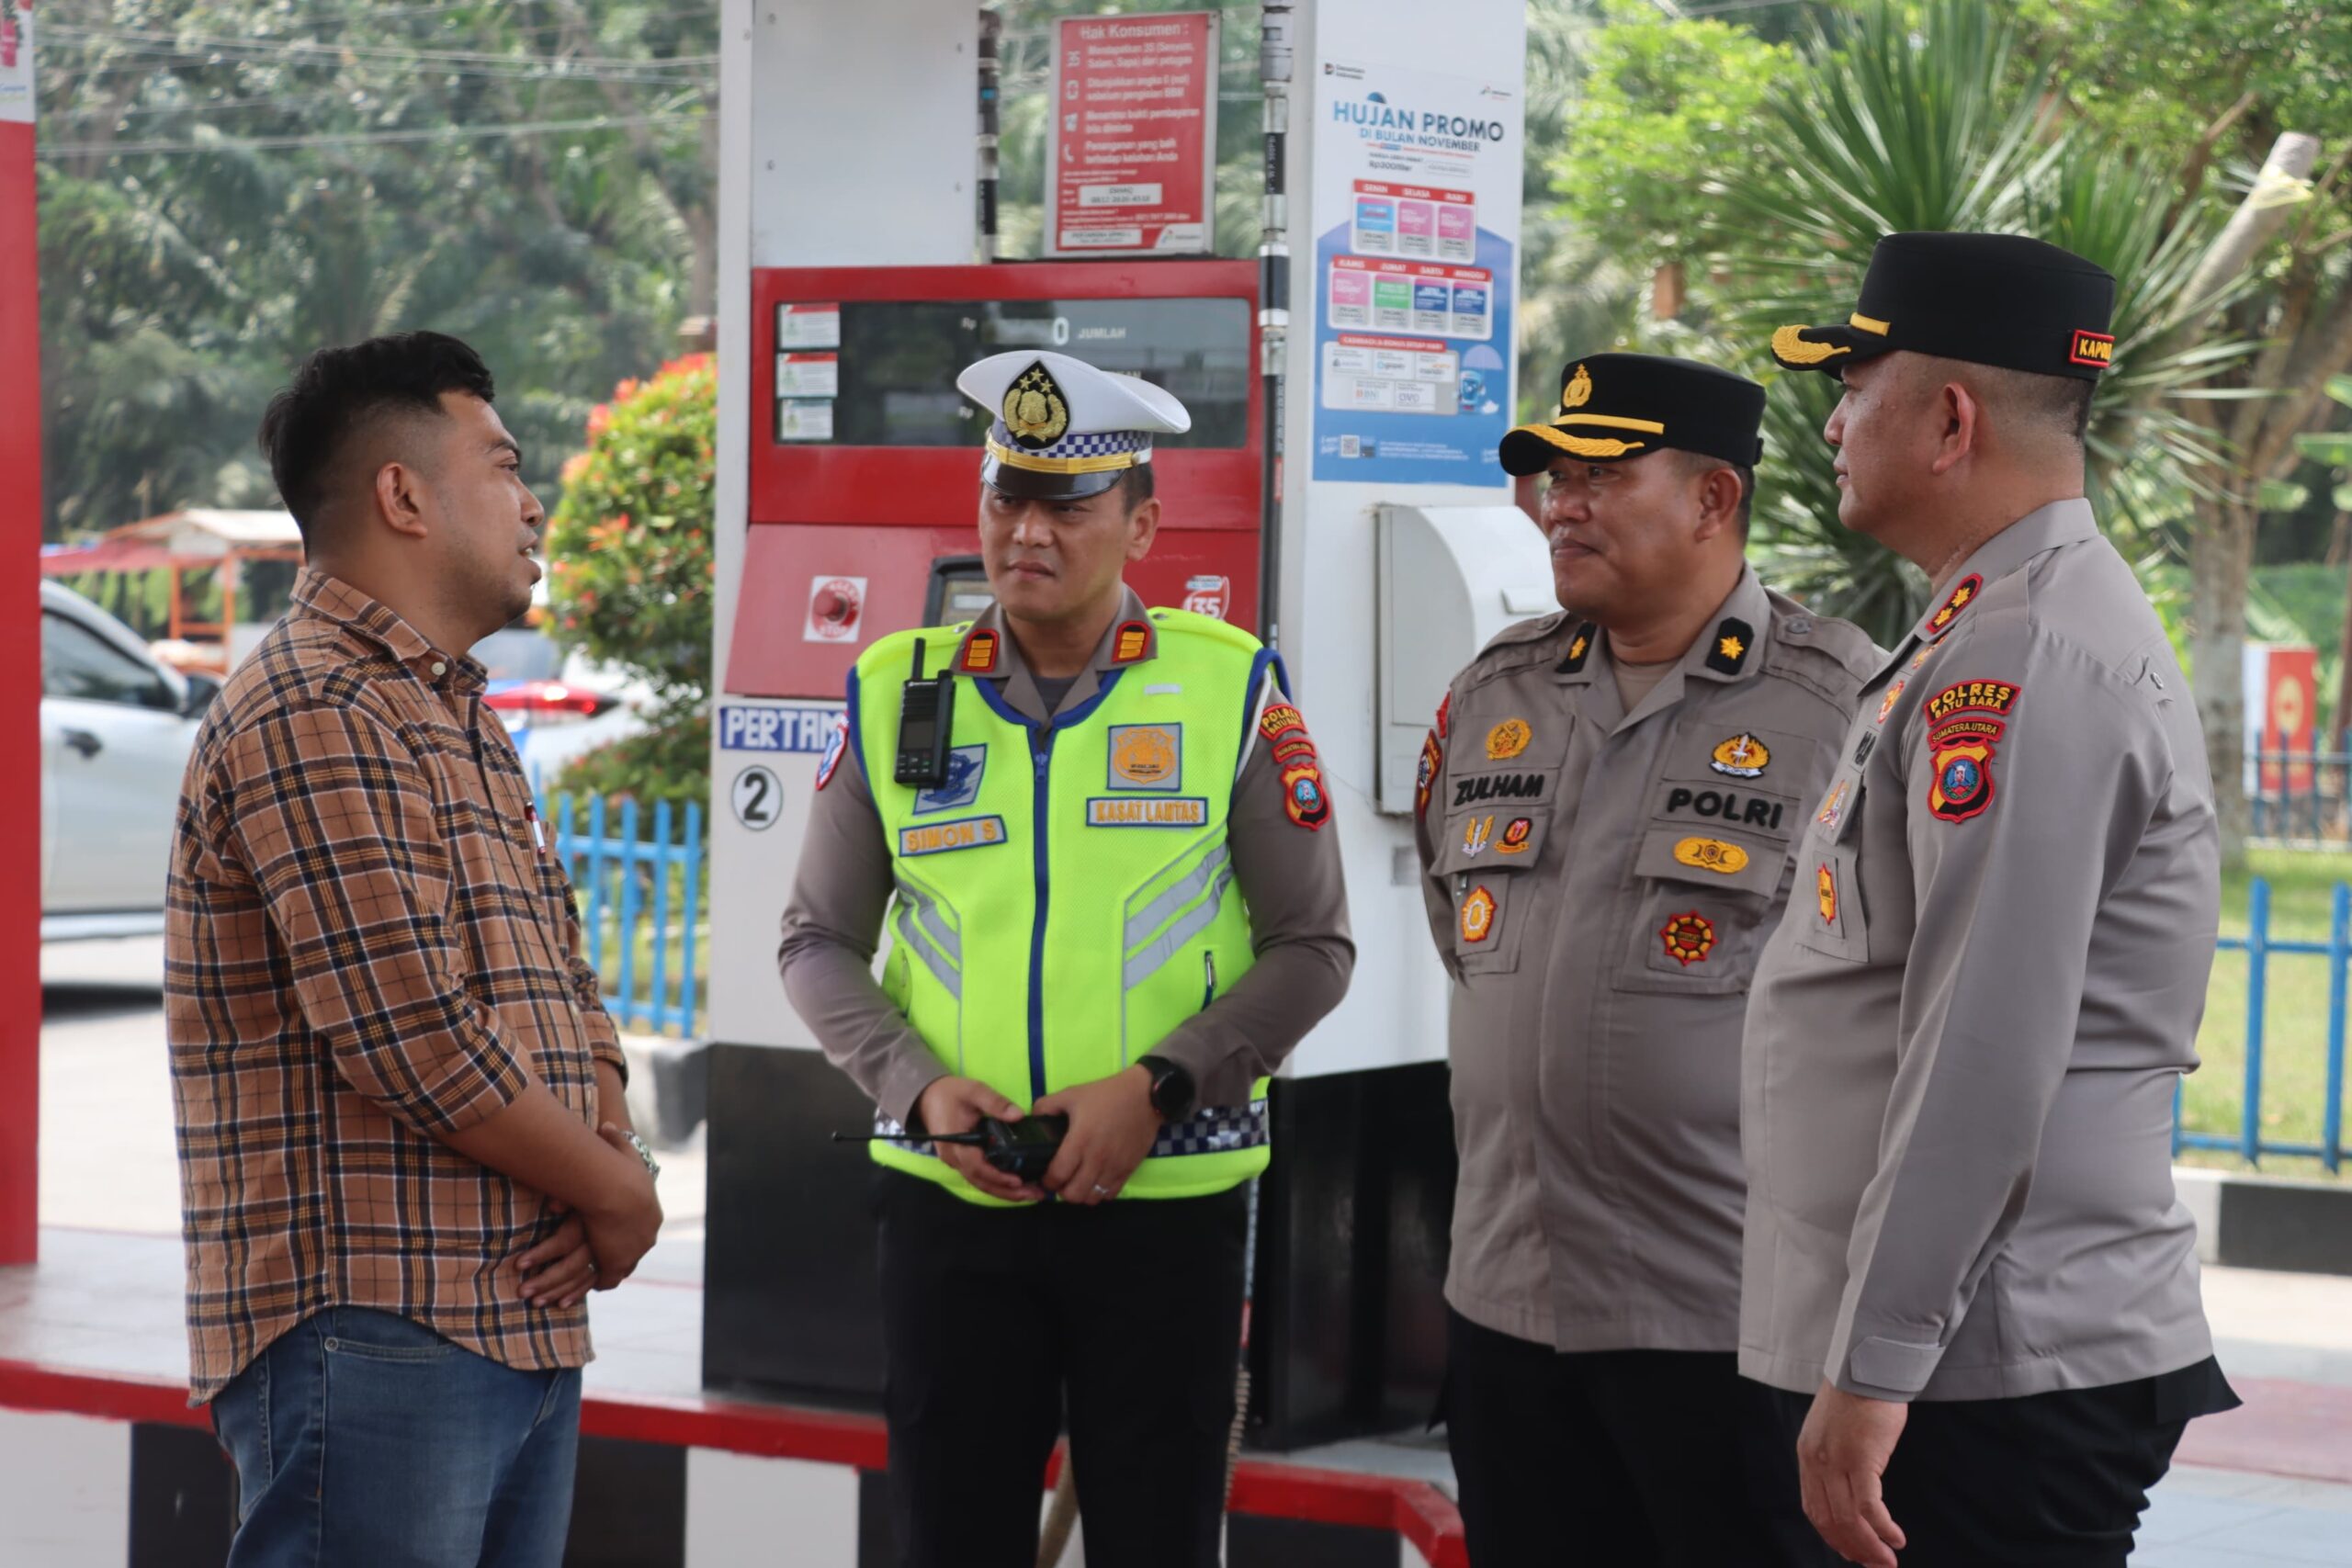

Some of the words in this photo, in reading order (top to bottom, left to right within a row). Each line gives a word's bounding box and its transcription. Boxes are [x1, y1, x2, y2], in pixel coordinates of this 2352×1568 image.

[1080, 26, 1105, 39] Hak
[1109, 24, 1181, 39] Konsumen
[1333, 100, 1415, 130] HUJAN
[1423, 113, 1504, 141] PROMO
[1360, 128, 1372, 139] DI
[1375, 130, 1415, 144] BULAN
[1419, 133, 1481, 152] NOVEMBER
[1053, 317, 1069, 345] 0
[1077, 327, 1126, 339] JUMLAH
[1930, 682, 2010, 713] POLRES
[1935, 698, 1963, 718] BATU
[1969, 696, 2001, 709] BARA
[1932, 722, 1970, 742] SUMATERA
[1971, 722, 1997, 736] UTARA
[743, 773, 769, 821] 2
[1453, 774, 1544, 807] ZULHAM
[1095, 801, 1143, 822] KASAT
[1146, 801, 1201, 823] LANTAS
[1667, 788, 1784, 829] POLRI
[906, 822, 975, 852] SIMON
[982, 819, 997, 840] S
